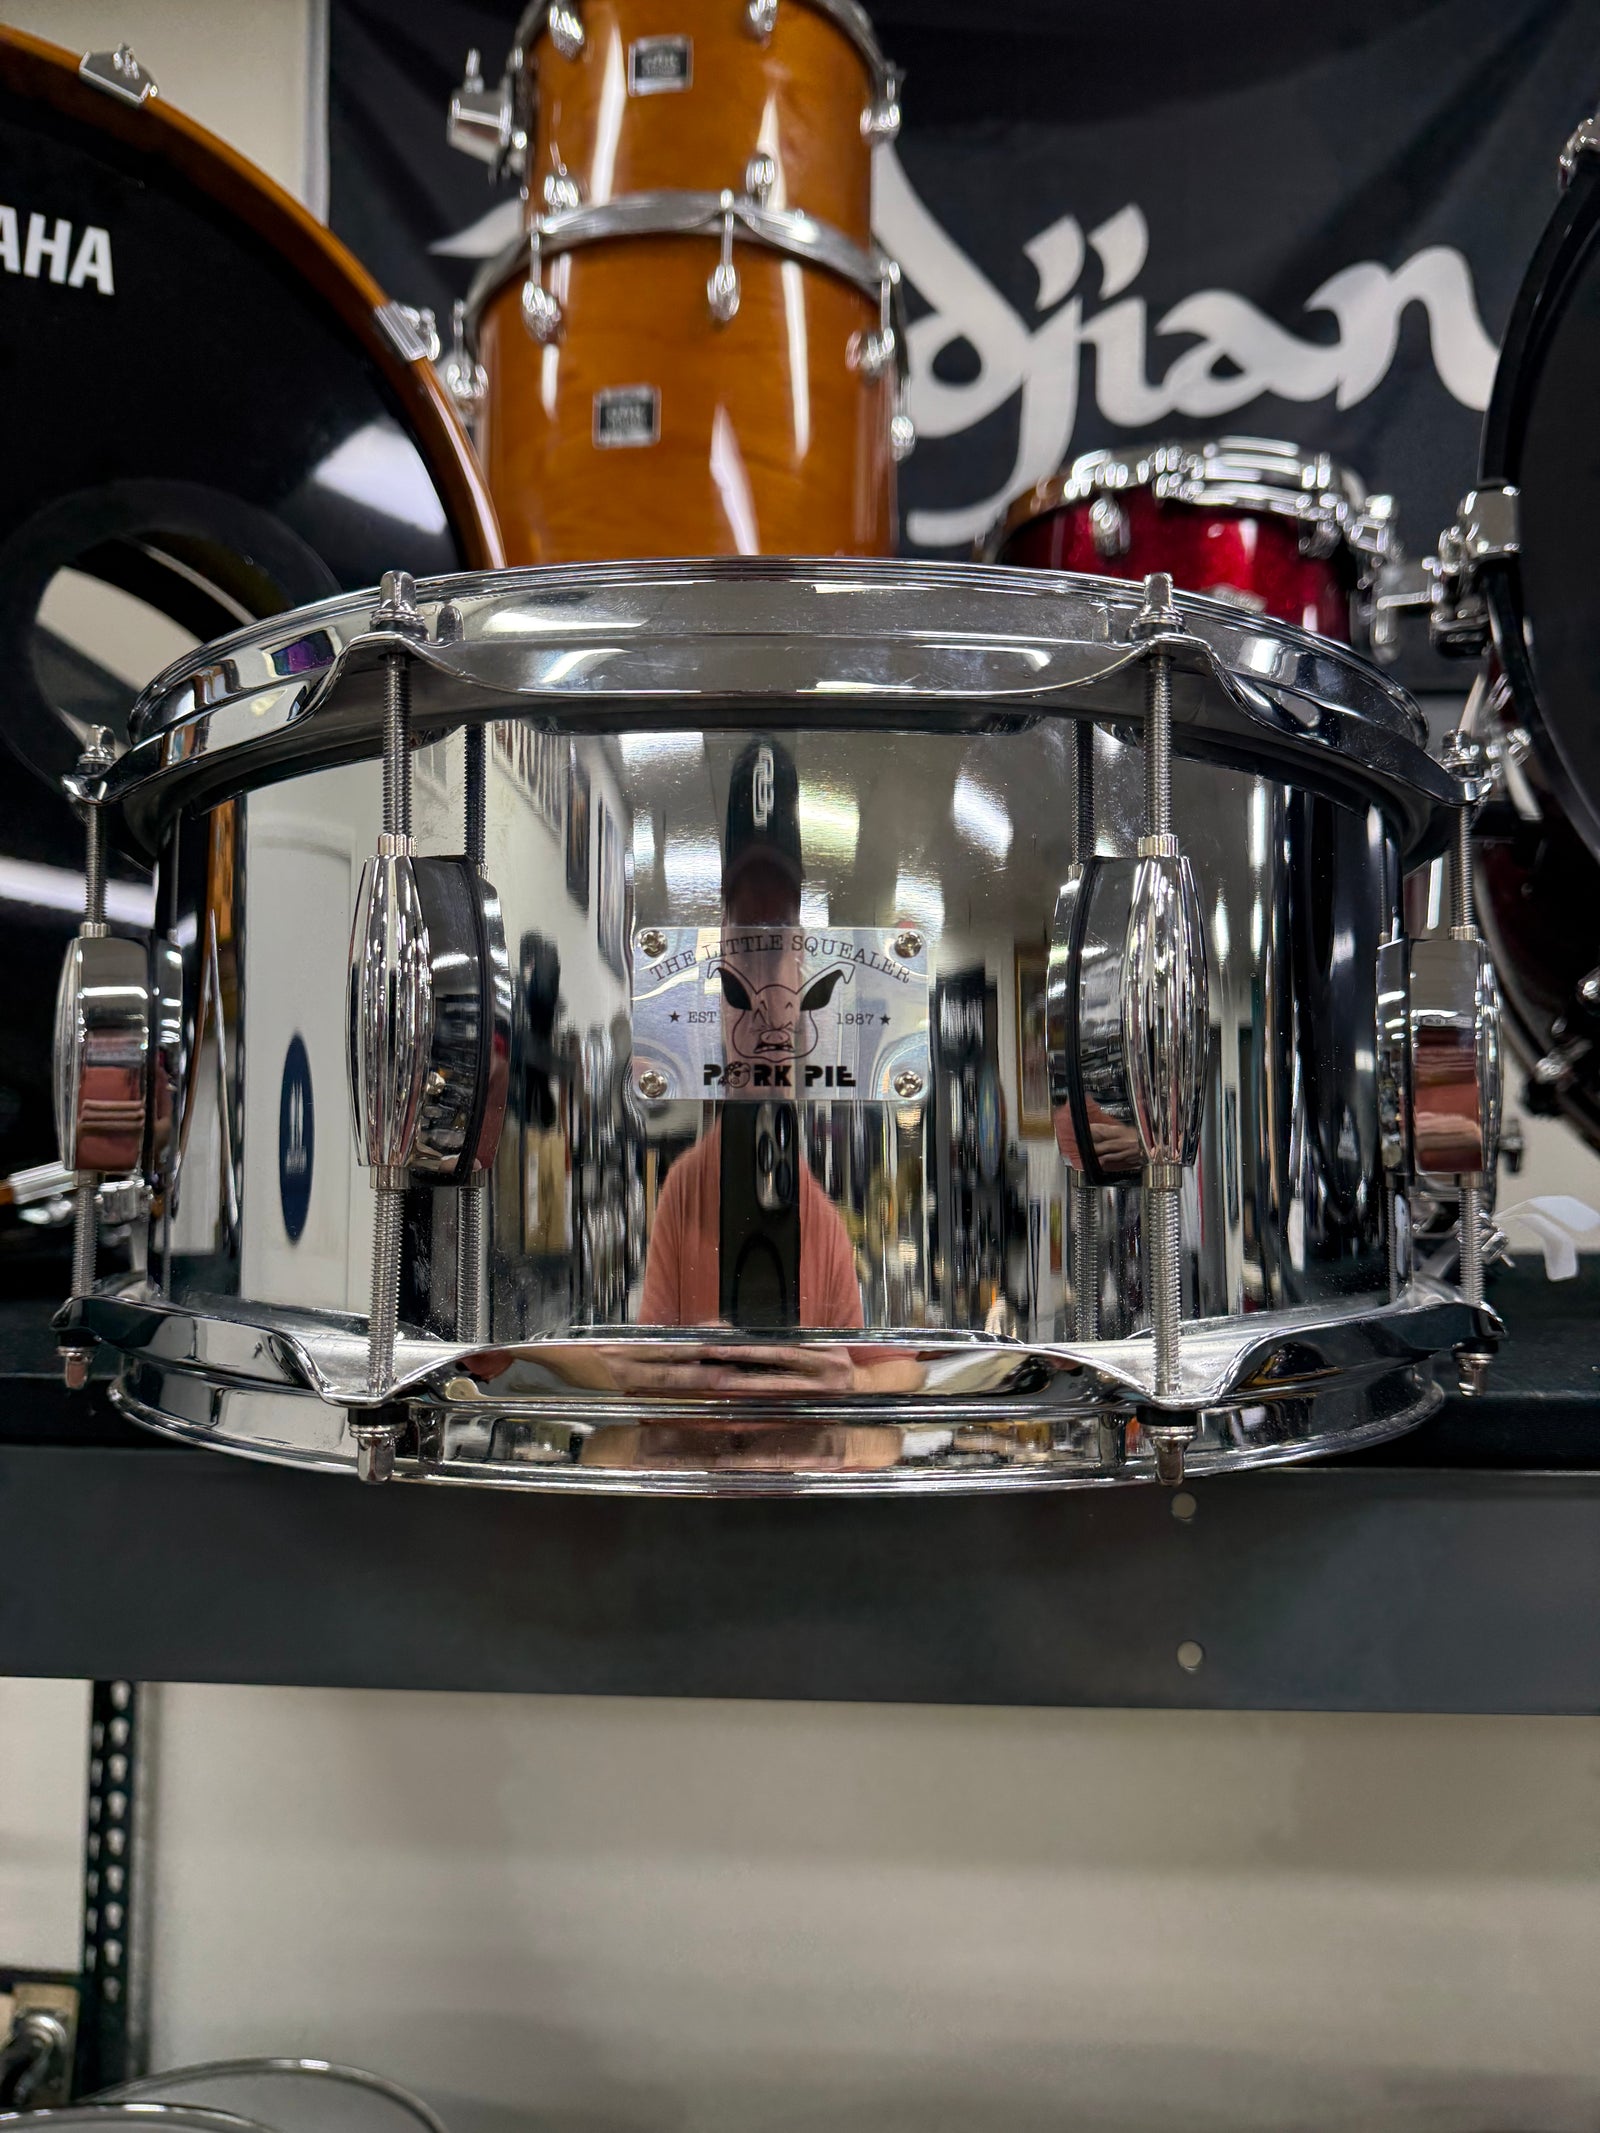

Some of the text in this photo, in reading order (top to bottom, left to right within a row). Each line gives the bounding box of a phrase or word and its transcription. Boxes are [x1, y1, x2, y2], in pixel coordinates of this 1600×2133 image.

[649, 934, 911, 984] THE LITTLE SQUEALER
[687, 1011, 875, 1026] EST 1987
[804, 1065, 856, 1088] PIE
